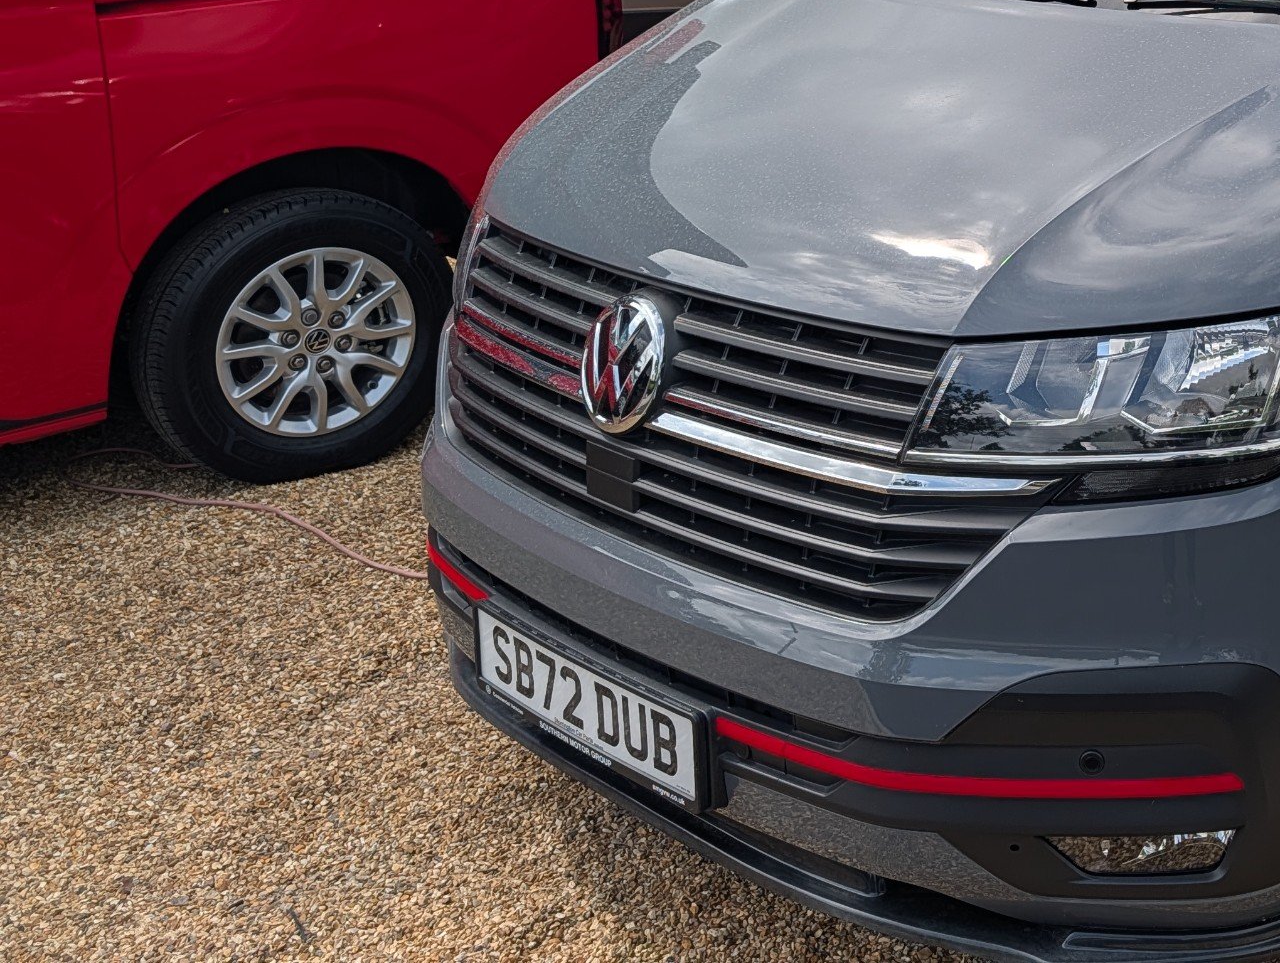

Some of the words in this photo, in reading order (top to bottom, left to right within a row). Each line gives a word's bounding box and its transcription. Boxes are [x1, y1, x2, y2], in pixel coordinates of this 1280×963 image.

[539, 720, 570, 744] SOUTHERN
[569, 738, 590, 756] MOTOR
[591, 750, 612, 768] GROUP
